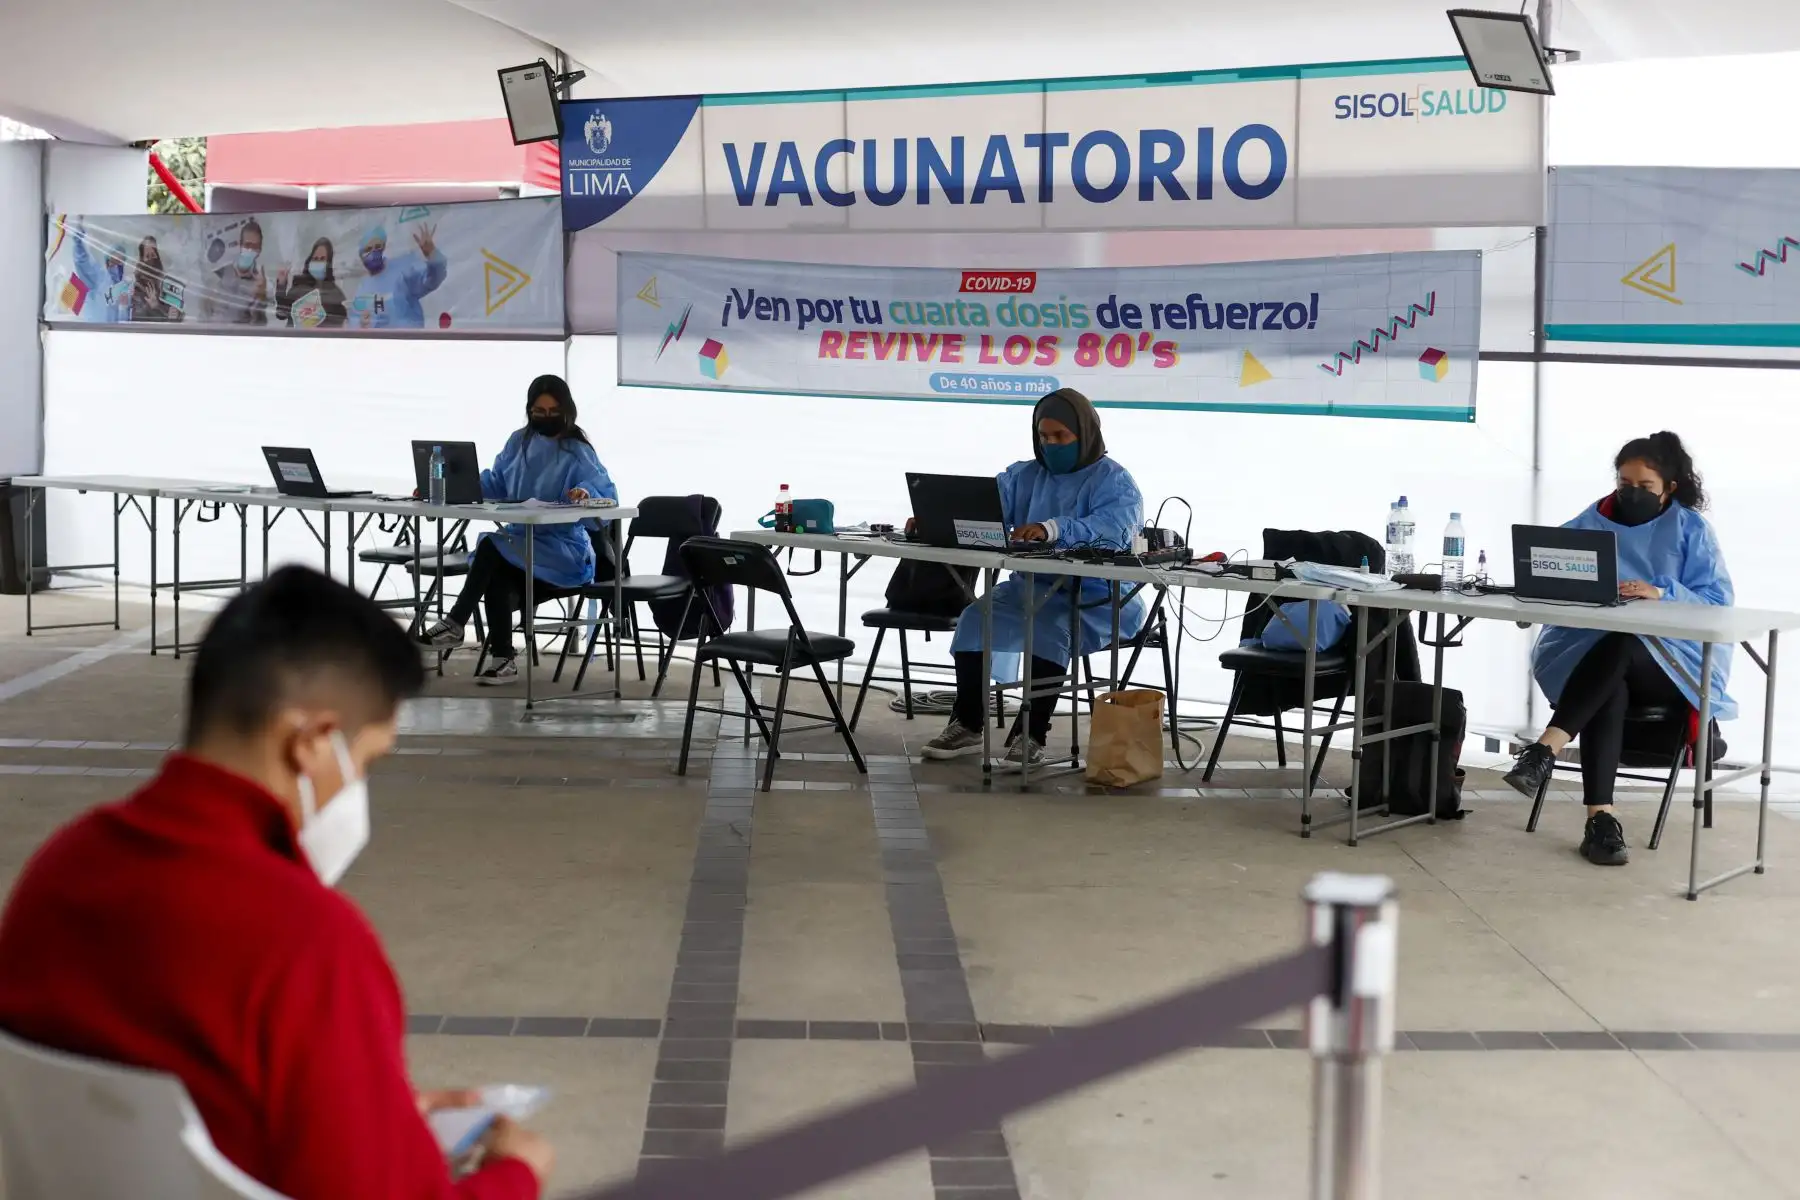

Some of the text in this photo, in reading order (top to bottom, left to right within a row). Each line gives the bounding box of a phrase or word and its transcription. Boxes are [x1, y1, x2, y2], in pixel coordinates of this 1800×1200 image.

[1334, 87, 1507, 119] SISOL SALUD
[622, 158, 631, 166] DE
[722, 124, 1288, 207] VACUNATORIO
[569, 173, 633, 195] LIMA
[965, 276, 1032, 291] COVID-19
[721, 287, 1319, 330] ¡Ven por tu cuarta dosis de refuerzo!
[817, 329, 1180, 368] REVIVE LOS 80's
[939, 376, 1053, 393] De 40 años a más
[956, 530, 1005, 541] SISOL SALUD
[1532, 560, 1597, 573] SISOL SALUD
